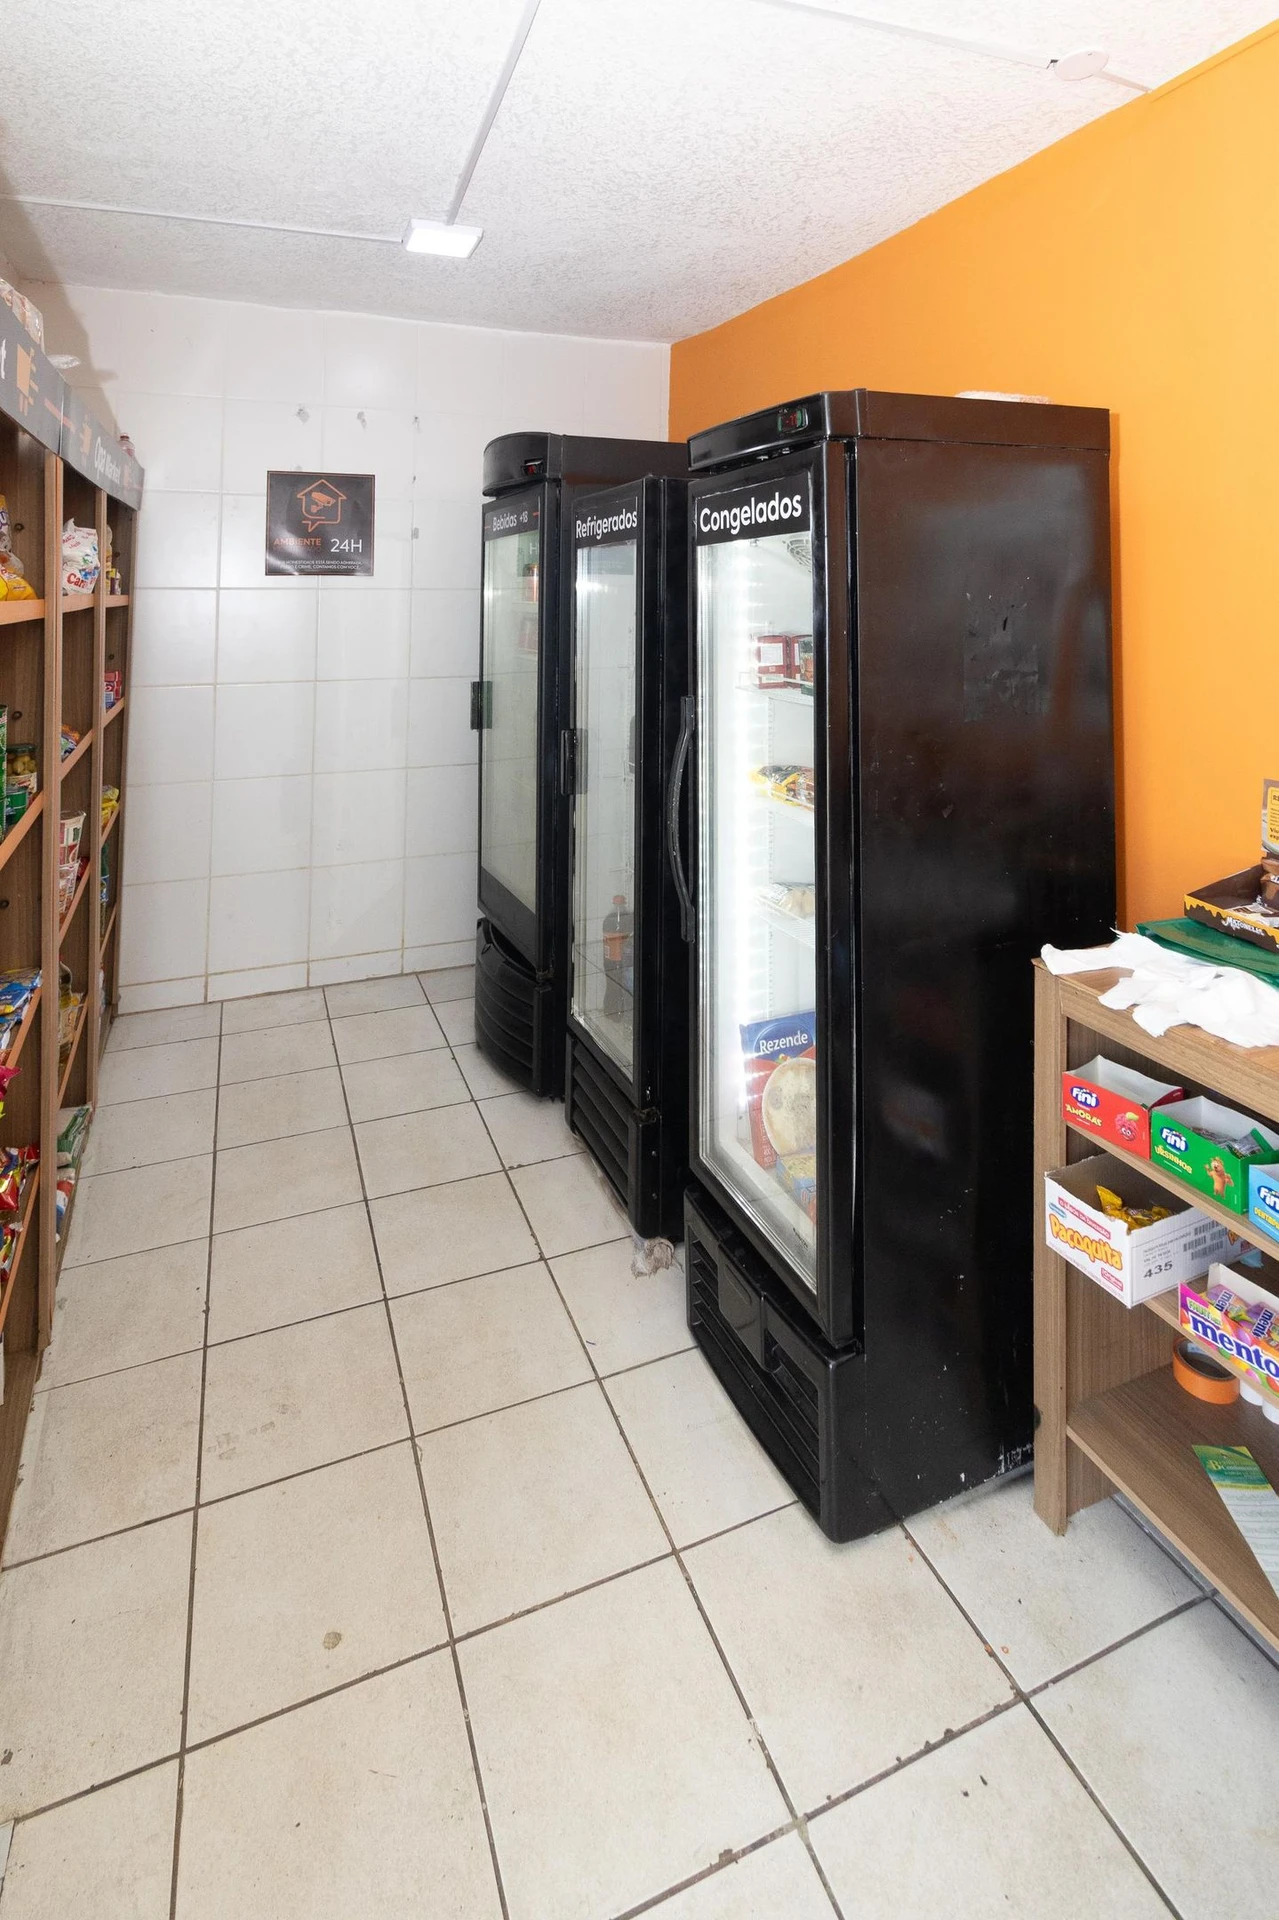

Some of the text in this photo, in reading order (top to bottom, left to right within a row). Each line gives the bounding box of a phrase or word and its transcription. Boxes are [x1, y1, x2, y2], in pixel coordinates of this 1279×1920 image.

[493, 511, 529, 532] Bebidas +18
[575, 509, 638, 540] Refrigerados
[700, 491, 802, 535] Congelados
[273, 537, 362, 553] AMBIENTE 24H
[759, 1030, 808, 1054] Rezende
[1072, 1087, 1097, 1108] Fini
[1065, 1103, 1103, 1127] AMORAS
[1161, 1128, 1187, 1151] Fini
[1154, 1144, 1193, 1175] URSINHOS
[1048, 1213, 1123, 1271] Paçoquita
[1143, 1260, 1173, 1279] 435
